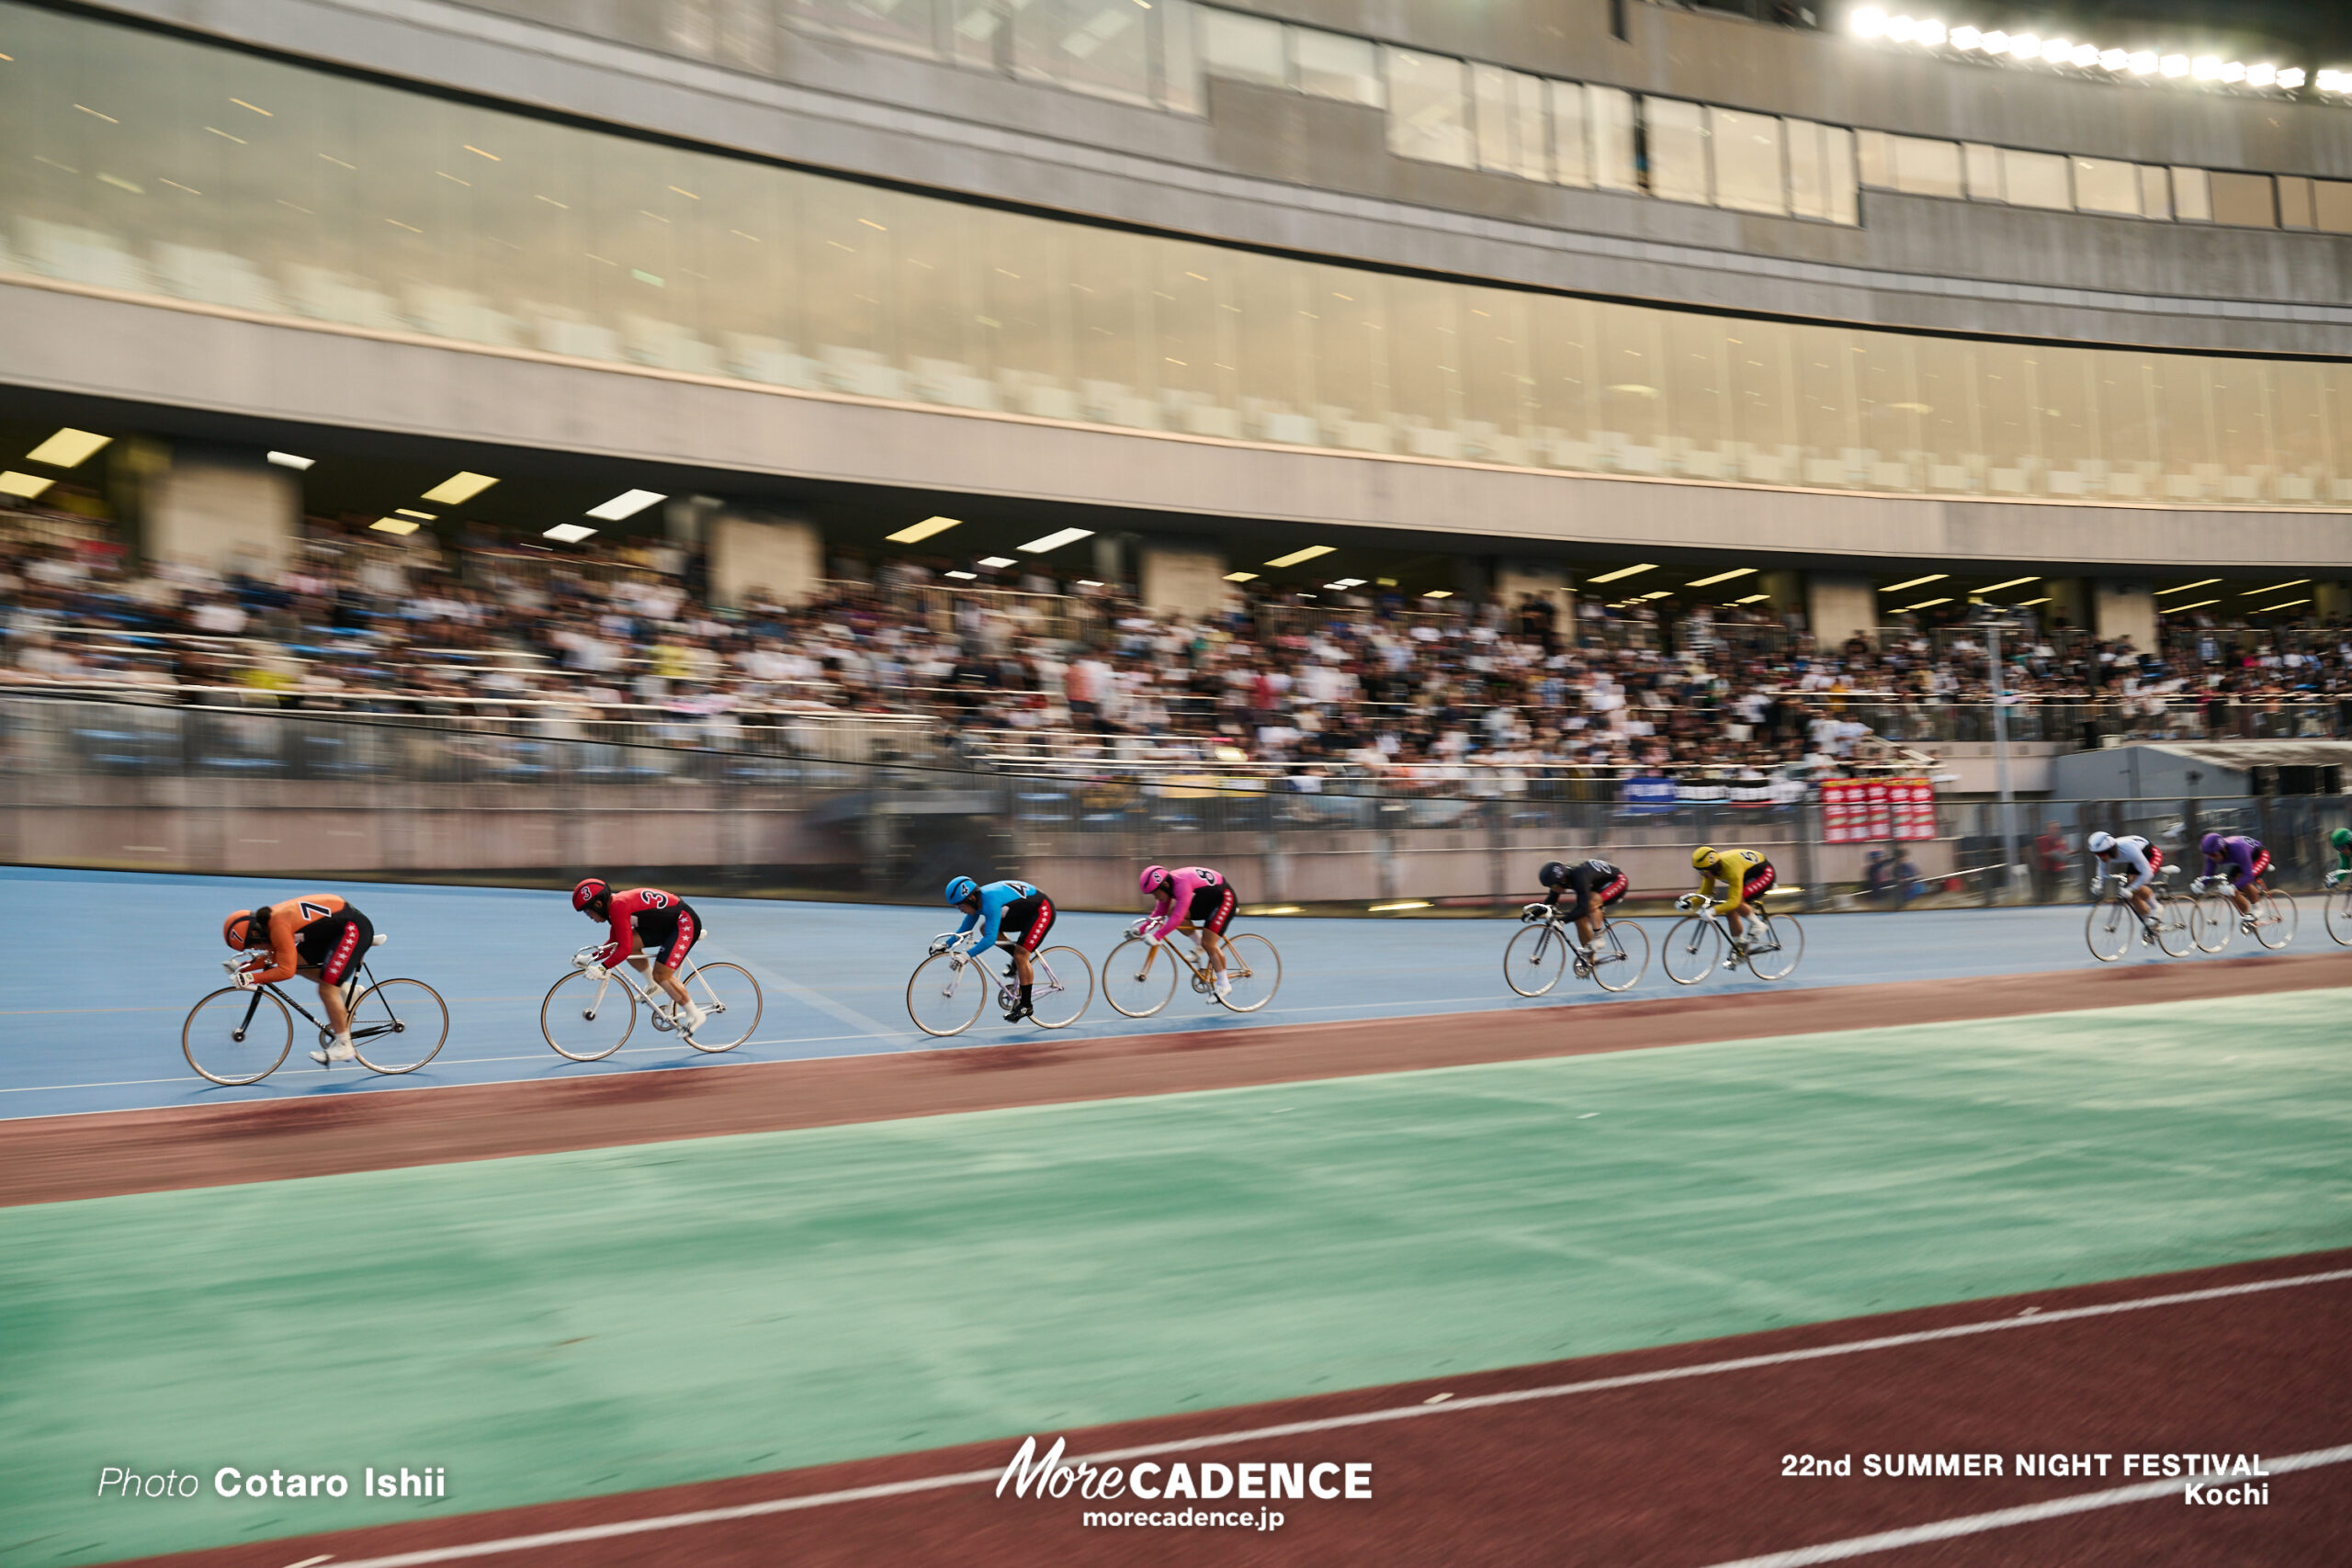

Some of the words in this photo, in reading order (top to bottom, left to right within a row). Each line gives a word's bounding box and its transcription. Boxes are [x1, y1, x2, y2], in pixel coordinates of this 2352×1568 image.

[1739, 851, 1758, 863] 5
[1195, 868, 1216, 886] 8
[581, 886, 592, 901] 3
[961, 883, 969, 897] 4
[1003, 882, 1030, 899] 4
[640, 889, 668, 909] 3
[299, 901, 332, 921] 7
[231, 930, 244, 943] 7
